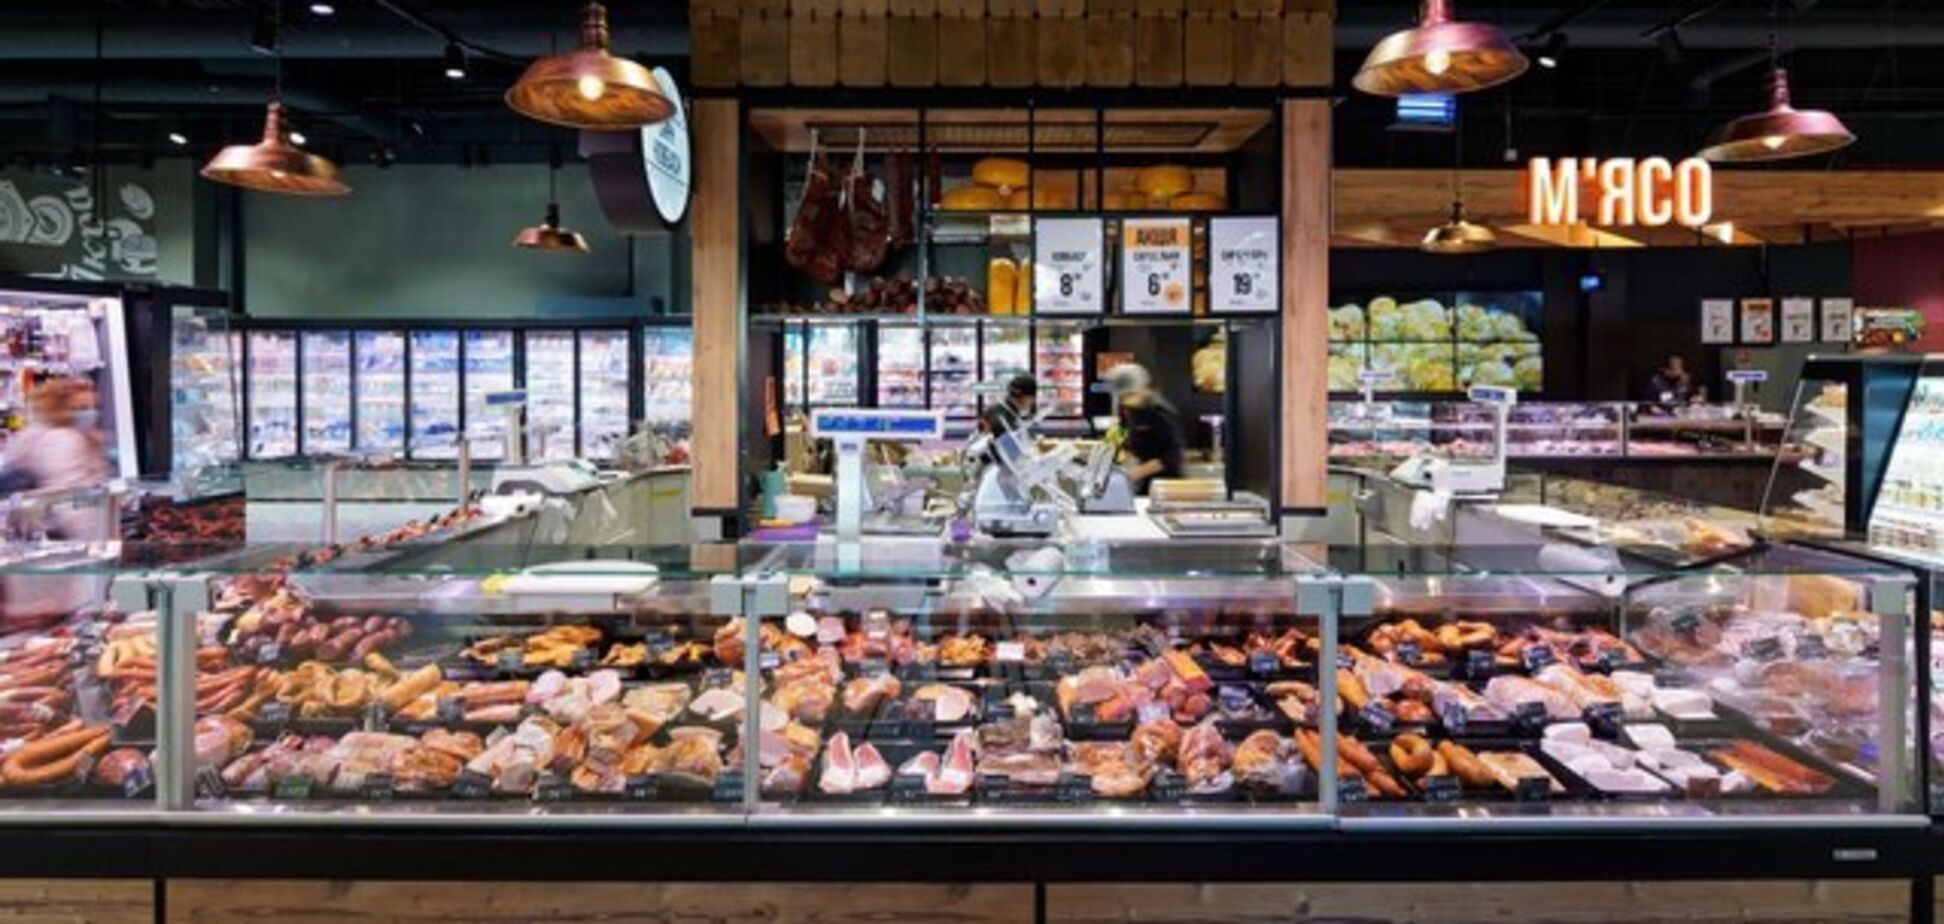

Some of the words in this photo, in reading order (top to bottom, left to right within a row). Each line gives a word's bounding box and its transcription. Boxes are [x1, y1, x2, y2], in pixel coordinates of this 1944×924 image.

[1529, 156, 1712, 226] М'ЯСО
[1060, 273, 1073, 296] 8
[1148, 273, 1161, 296] 6
